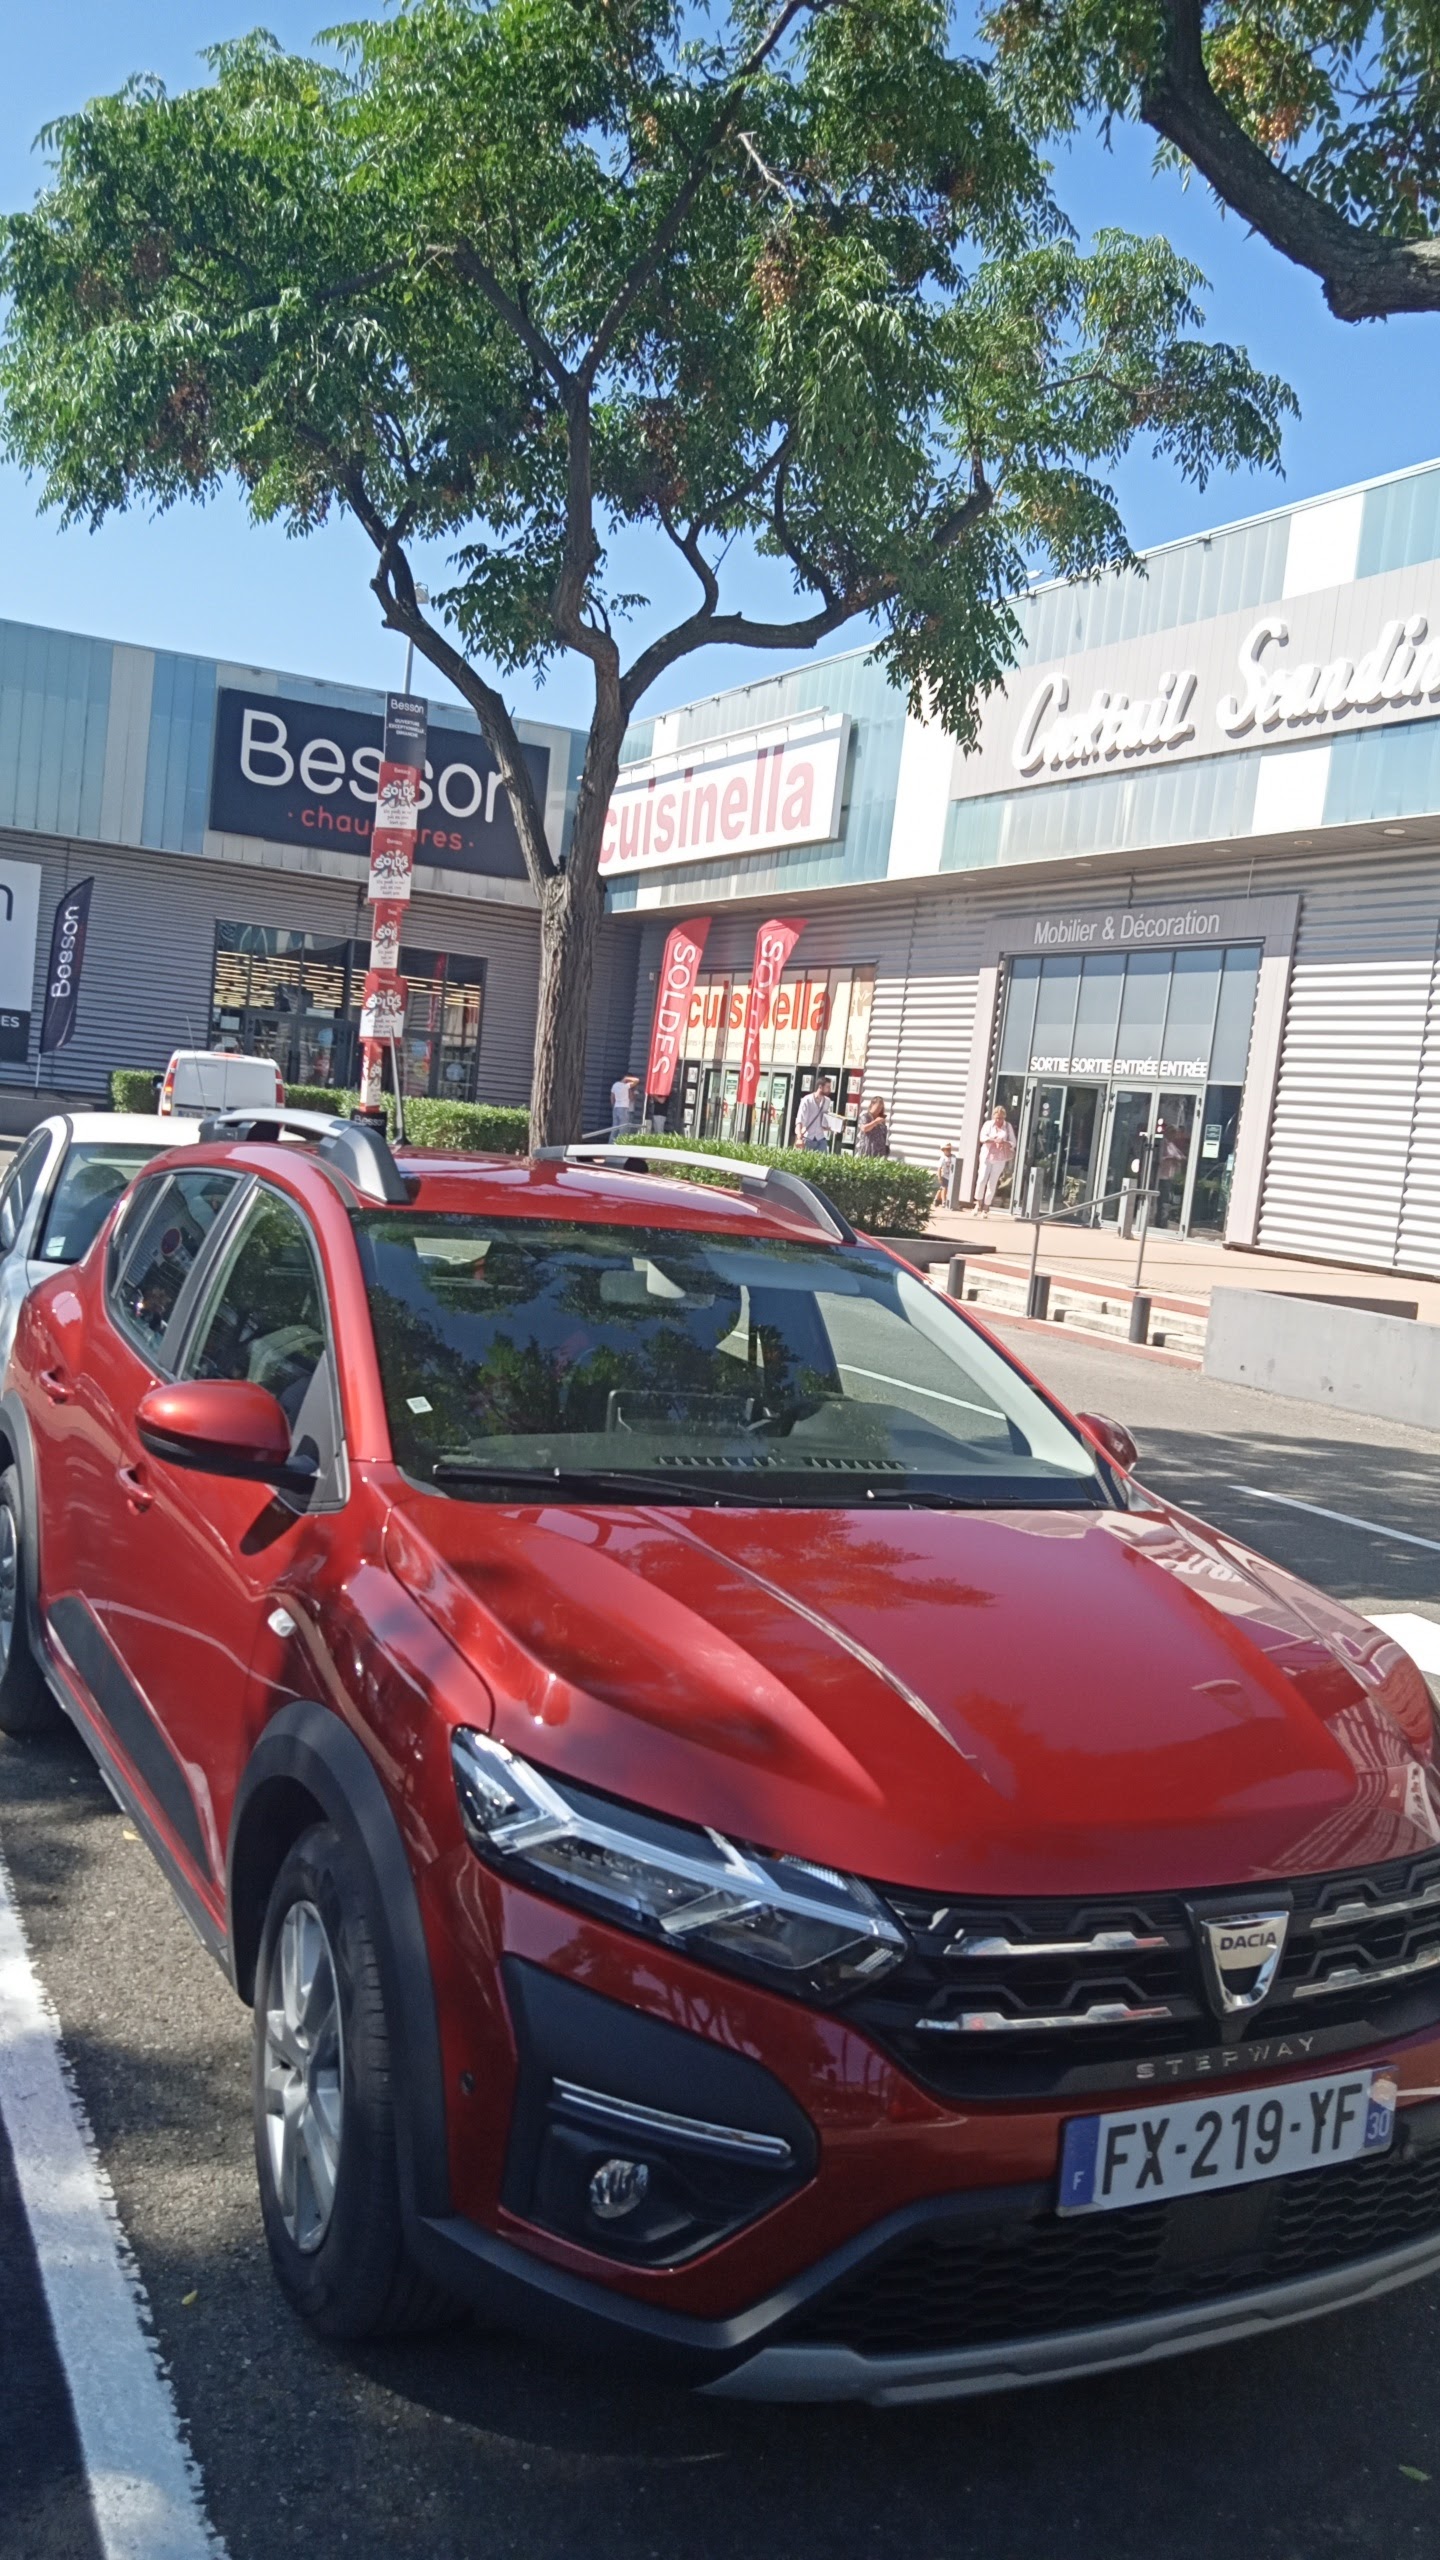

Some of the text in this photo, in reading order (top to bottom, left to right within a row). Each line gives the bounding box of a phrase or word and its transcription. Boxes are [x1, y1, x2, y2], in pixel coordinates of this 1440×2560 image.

[390, 699, 424, 714] Besson
[1012, 672, 1197, 775] Cocktail
[301, 805, 463, 851] chaures
[599, 744, 814, 864] cuisinella
[51, 905, 80, 998] Besson
[1034, 911, 1220, 944] Mobilier & Décoration
[652, 941, 696, 1074] SOLDES
[687, 979, 831, 1031] cuisiella
[1030, 1056, 1208, 1078] SORTIE SORTIE ENTRÉE ENTRÉE
[1220, 1932, 1276, 1950] DACIA
[1136, 2036, 1313, 2079] STEPWAY
[1072, 2083, 1390, 2195] F FX-219-YF 30
